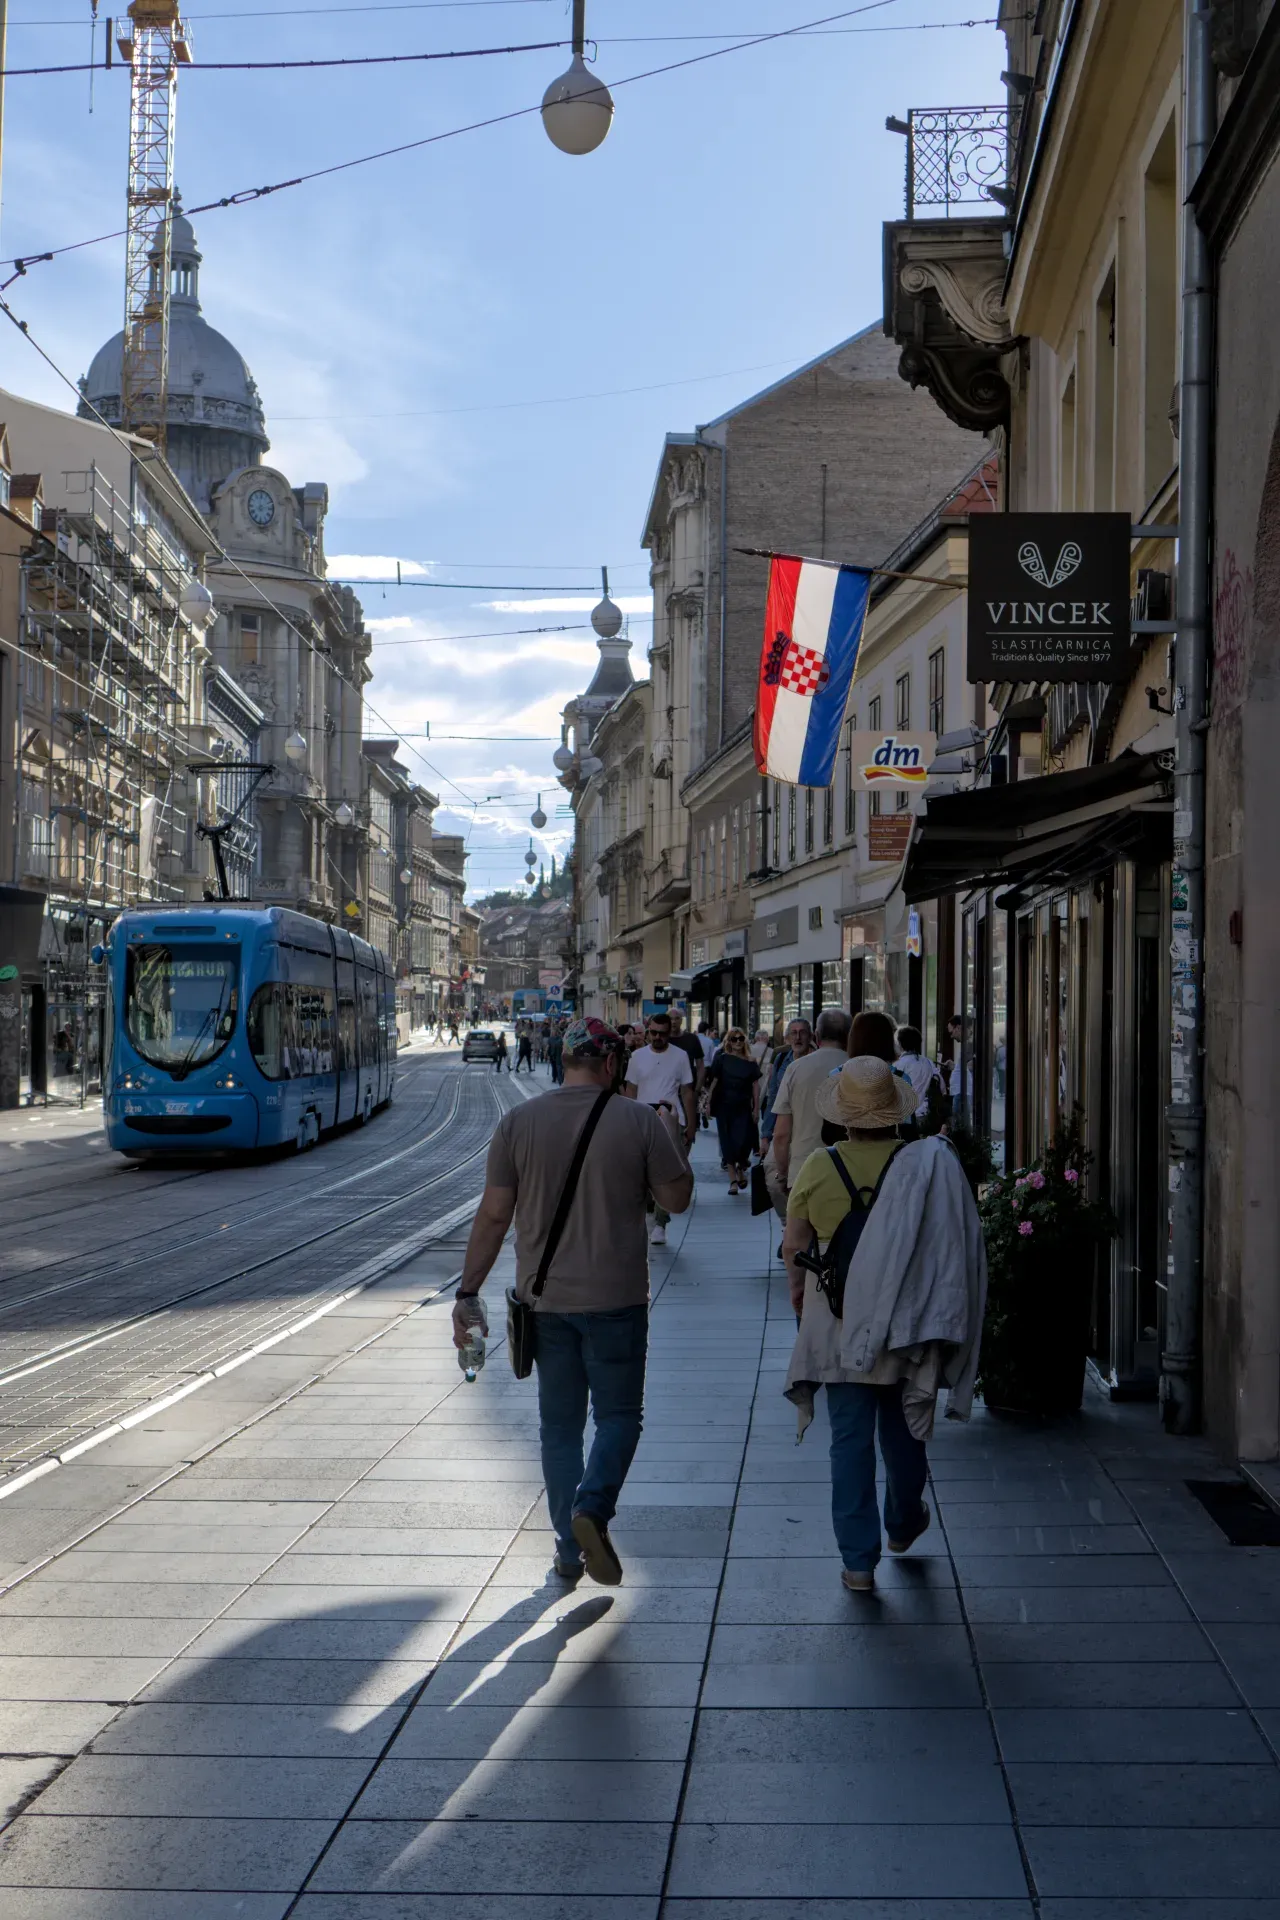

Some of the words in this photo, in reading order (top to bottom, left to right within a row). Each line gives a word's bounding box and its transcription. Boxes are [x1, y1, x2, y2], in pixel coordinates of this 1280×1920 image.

[986, 602, 1112, 625] VINCEK
[991, 637, 1111, 650] SLASTIČARNICA
[991, 653, 1027, 661] Tradition
[1035, 653, 1065, 663] Quality
[1067, 653, 1089, 661] Since
[1091, 653, 1111, 661] 1977
[874, 739, 920, 766] dm
